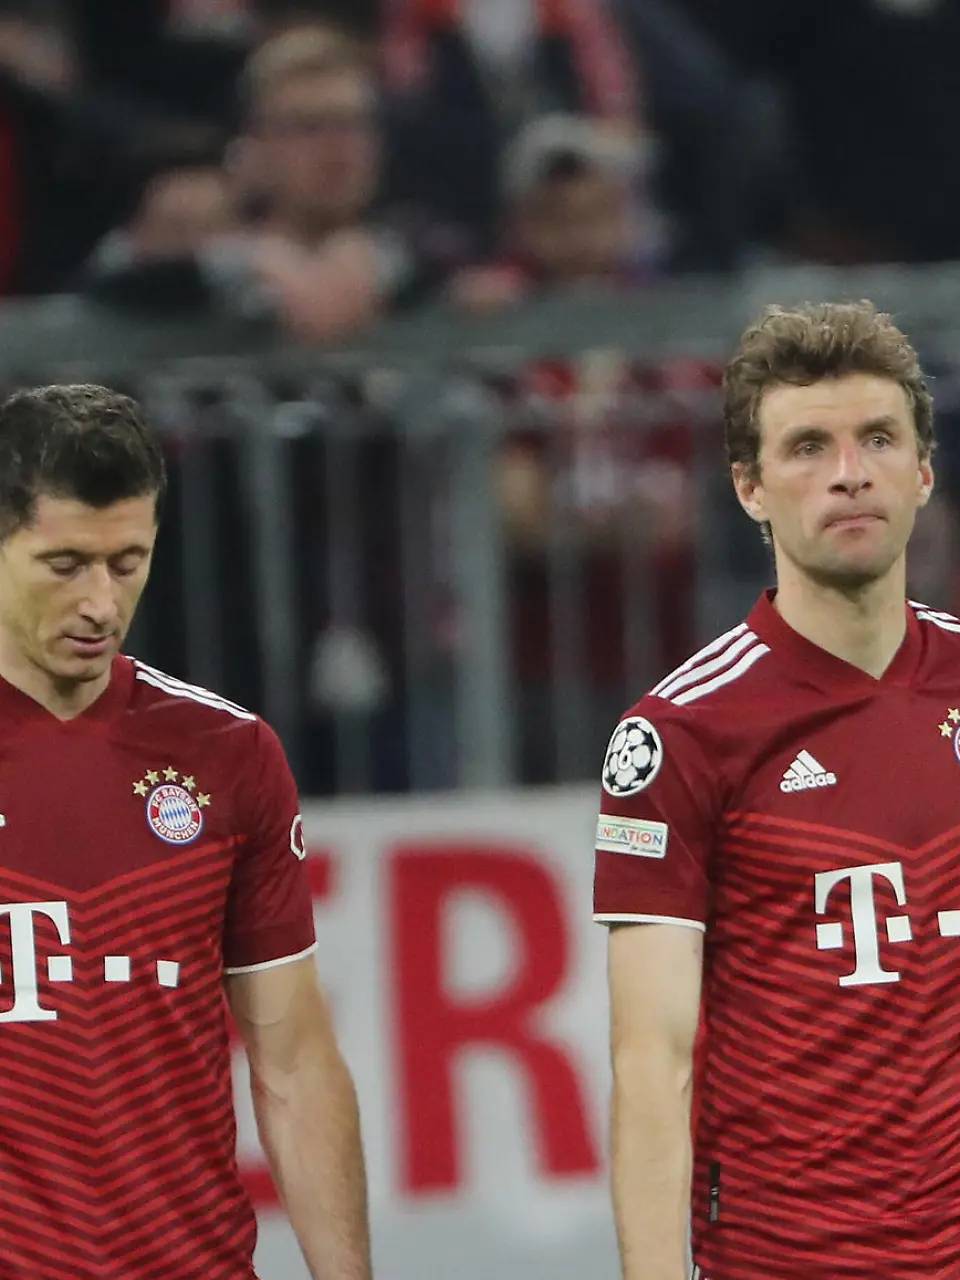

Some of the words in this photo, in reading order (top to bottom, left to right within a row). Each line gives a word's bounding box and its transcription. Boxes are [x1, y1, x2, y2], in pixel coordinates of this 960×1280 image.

[779, 772, 837, 793] adidas
[600, 826, 663, 845] NDATION
[814, 862, 911, 987] T
